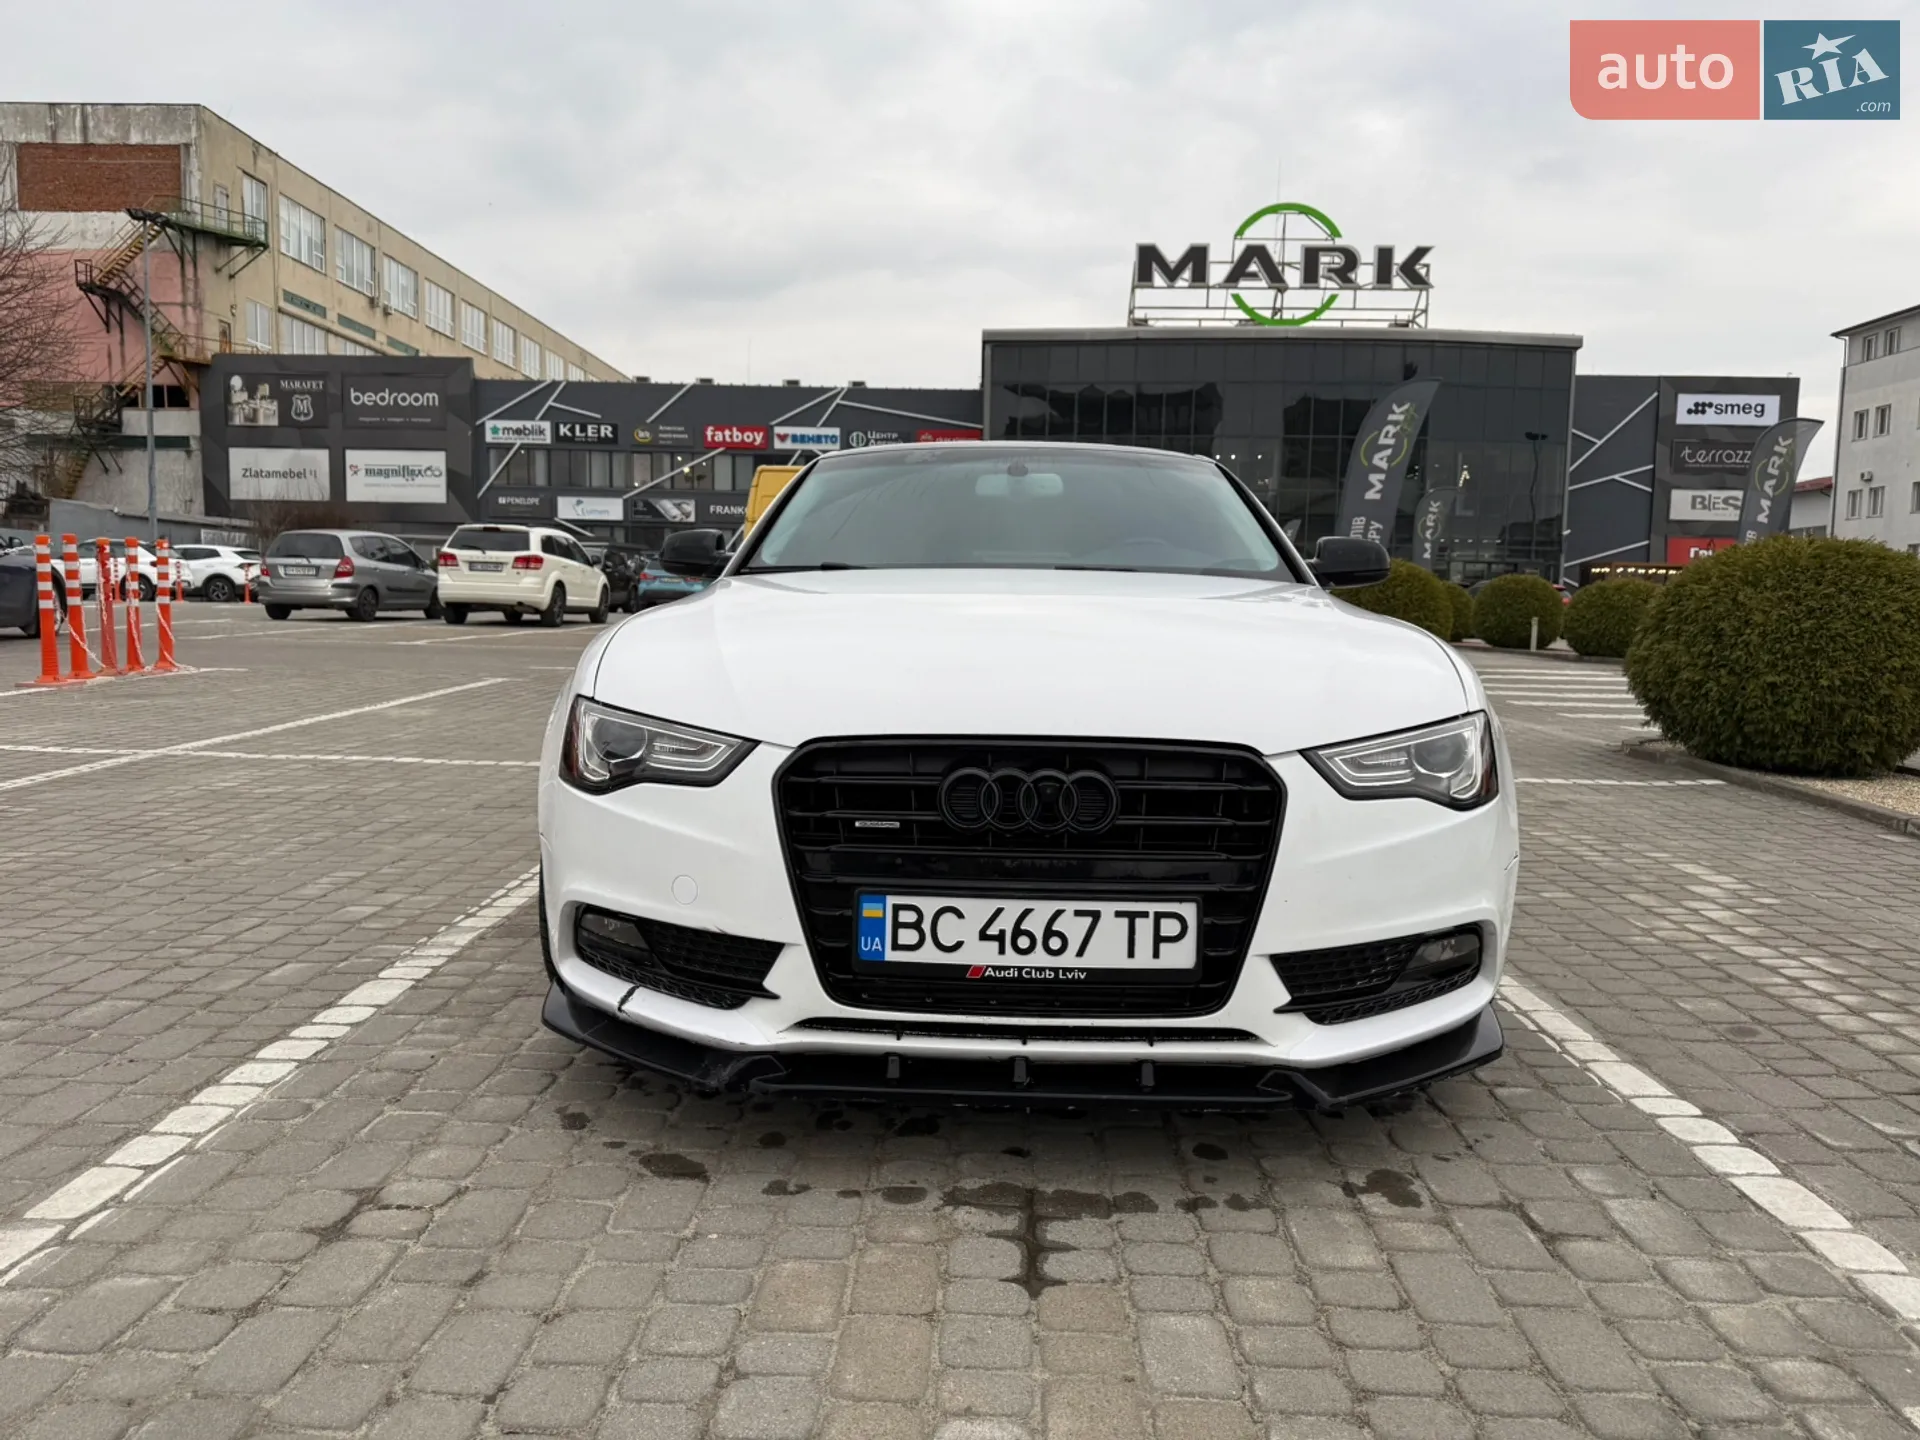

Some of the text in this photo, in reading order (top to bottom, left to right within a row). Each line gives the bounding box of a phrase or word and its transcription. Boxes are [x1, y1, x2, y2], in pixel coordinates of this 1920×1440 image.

[1135, 243, 1435, 290] MARK
[279, 379, 324, 390] MARAFET
[350, 388, 439, 406] bedroom
[1713, 403, 1766, 418] smeg
[558, 423, 614, 438] KLER
[705, 426, 764, 445] fatboy
[791, 433, 838, 445] ВЕНЕТО
[1364, 402, 1411, 500] MARK
[1680, 446, 1752, 463] terrazz
[241, 467, 307, 480] Zlatamebel
[363, 464, 424, 480] magniflex
[1757, 436, 1793, 524] MARK
[1350, 516, 1366, 539] ЛІВ
[1368, 520, 1383, 543] РУ
[1423, 500, 1441, 559] MARK
[890, 903, 1189, 960] BC 4667 TP
[861, 937, 882, 951] UA
[984, 967, 1087, 980] Audi Club Lviv
